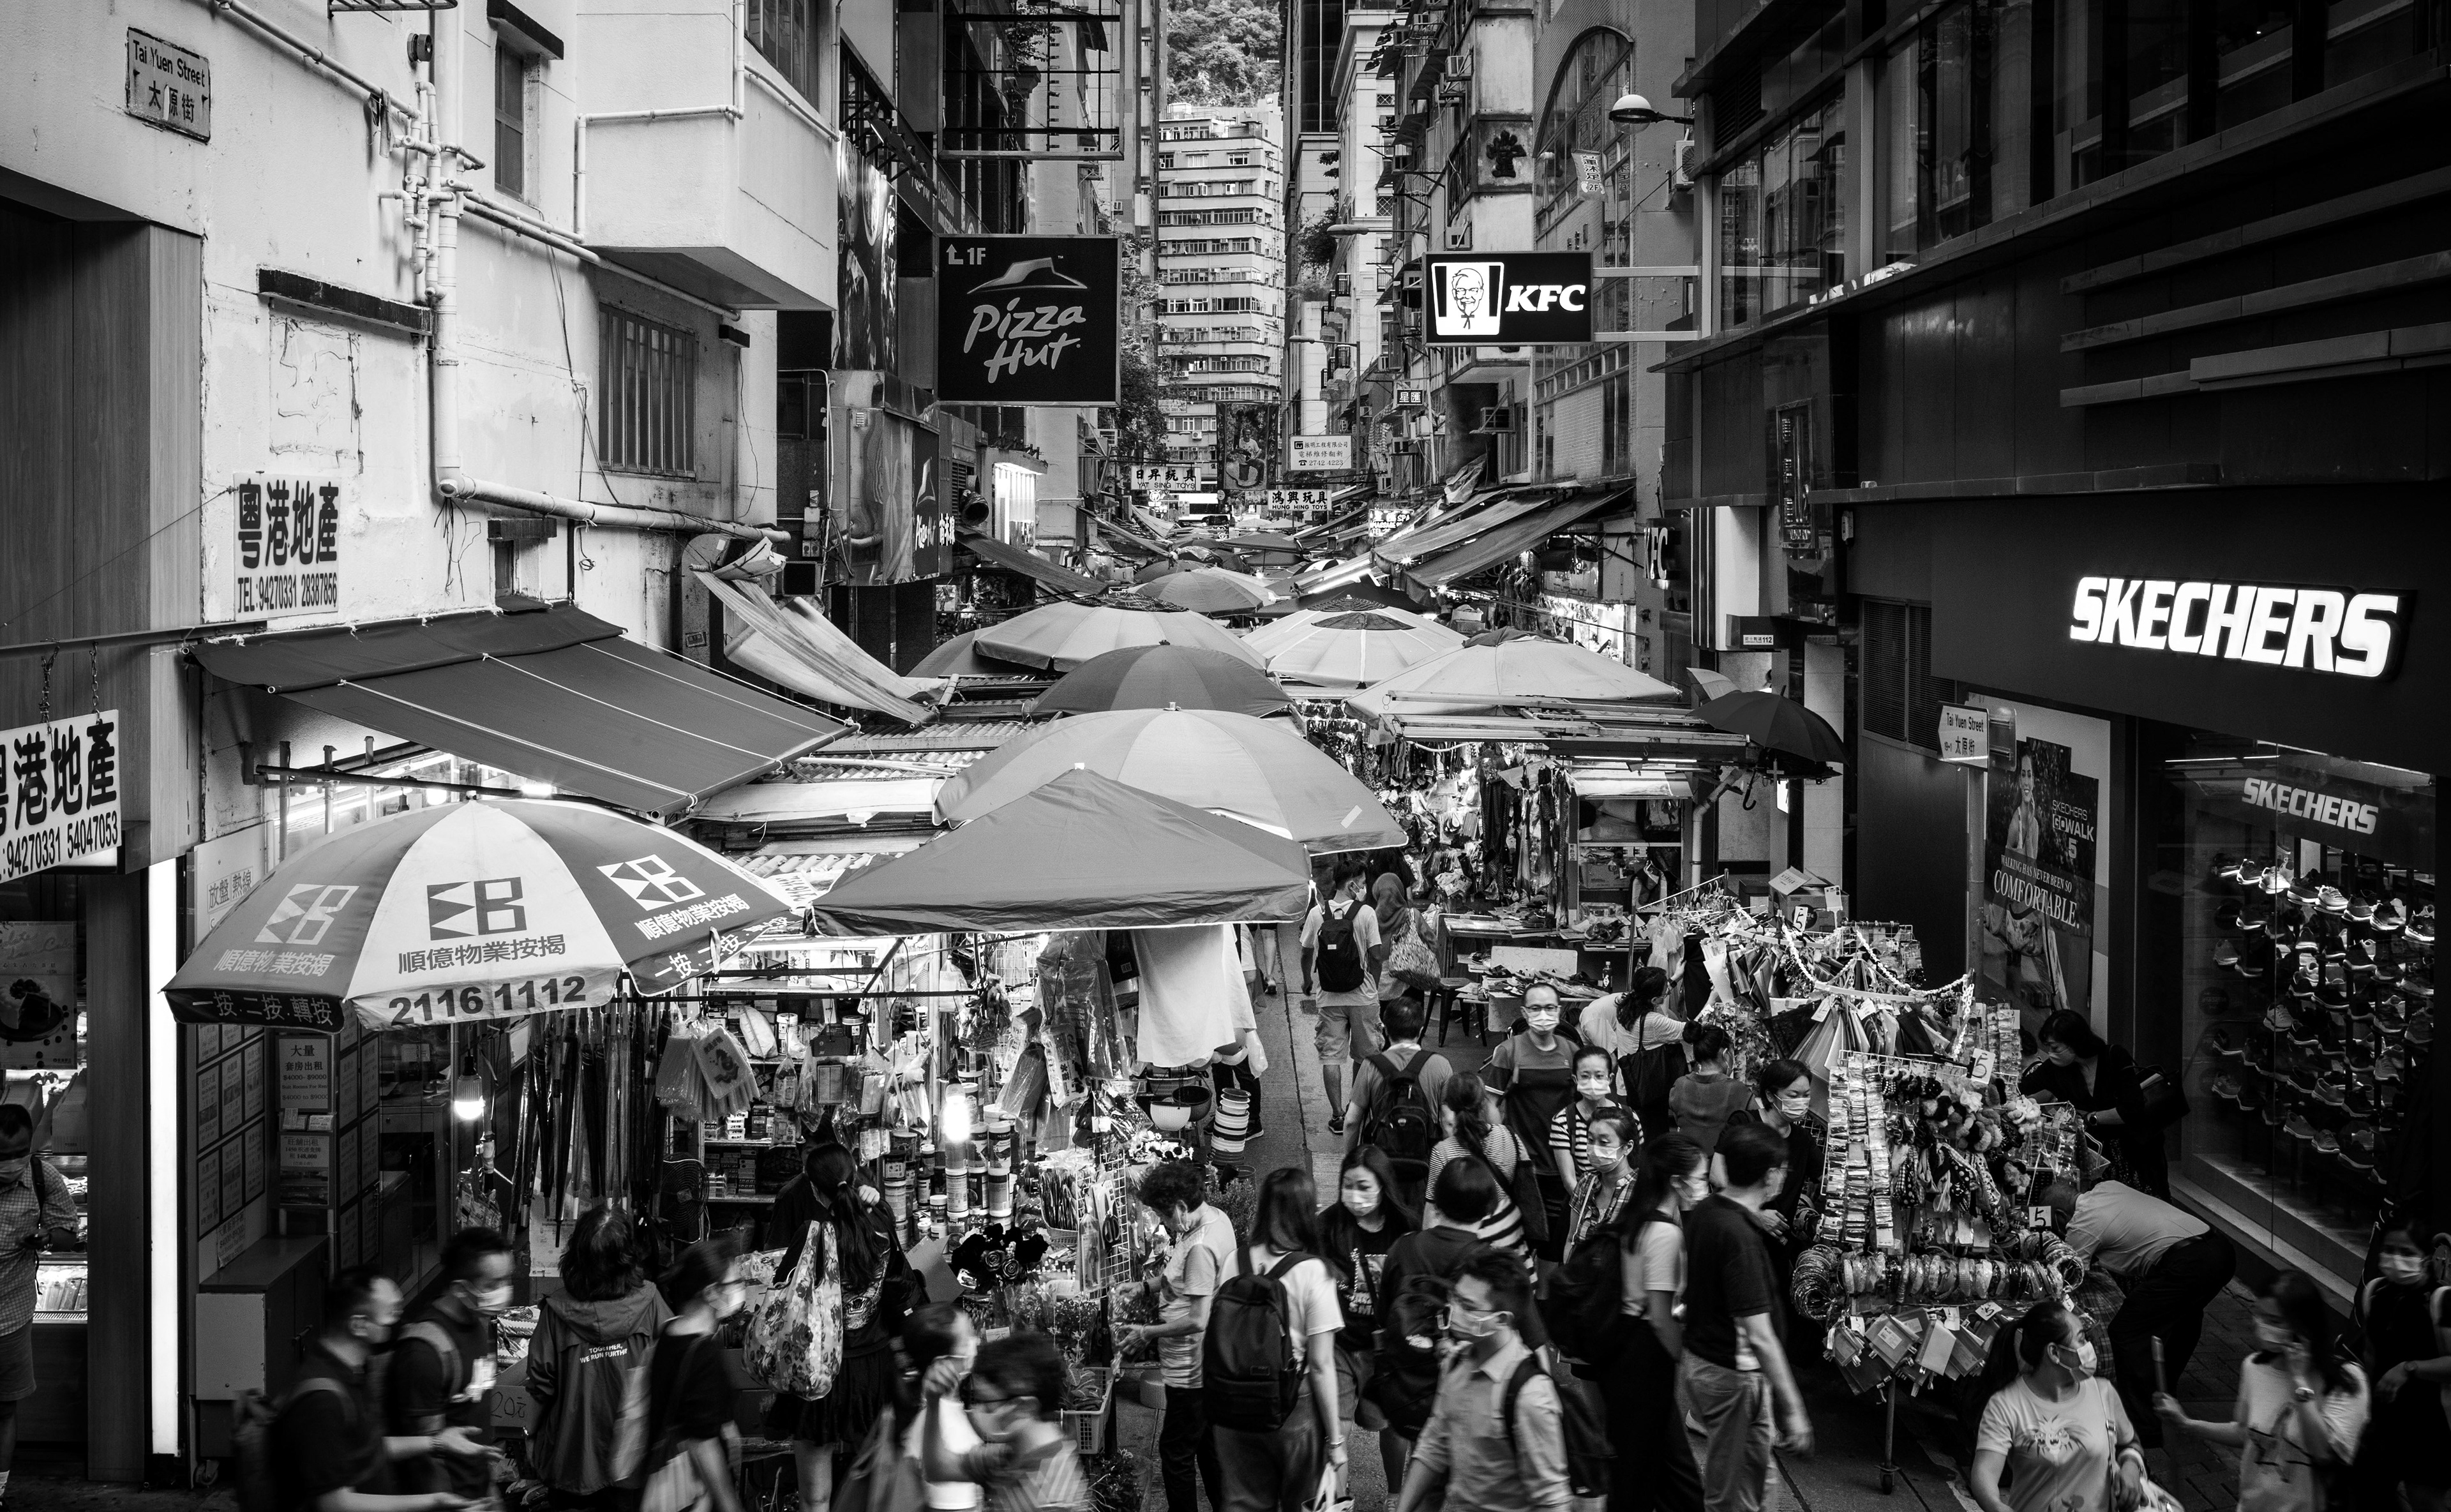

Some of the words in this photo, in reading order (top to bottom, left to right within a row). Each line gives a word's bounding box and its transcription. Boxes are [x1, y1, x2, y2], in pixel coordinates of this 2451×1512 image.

[133, 39, 147, 64] Tai
[150, 47, 173, 74] Yuen
[177, 57, 205, 87] Street
[148, 80, 195, 123] 太原街
[967, 247, 986, 265] 1F
[1504, 284, 1586, 312] KFC
[963, 297, 1086, 354] Pizza
[984, 333, 1081, 384] Hut
[1398, 392, 1421, 403] 星匯
[1136, 468, 1196, 482] 日昇玩具
[1272, 490, 1328, 504] 鴻興玩具
[237, 478, 339, 569] 粵港地產
[1644, 527, 1668, 580] KFC
[301, 573, 337, 608] 28387856
[2070, 576, 2399, 678] SKECHERS
[1955, 714, 1967, 729] Yuen
[1968, 716, 1984, 732] Street
[1955, 736, 1975, 758] 太原街
[2052, 800, 2088, 821] SKECHERS
[2244, 777, 2379, 835] SKECHERS
[67, 811, 118, 859] 54047053
[2068, 837, 2077, 859] 5
[2001, 854, 2022, 873] WALKING
[2022, 863, 2032, 878] HAS
[2032, 867, 2050, 885] NEVER
[2050, 875, 2065, 890] BEEN
[2065, 880, 2072, 894] SO
[1993, 869, 2080, 929] COMFORTABLE.
[634, 894, 751, 941] 順億物業按揭
[214, 949, 336, 977] 順億物業按揭
[398, 934, 566, 975] 順億物業按揭
[388, 987, 484, 1026] 2116
[494, 976, 587, 1012] 1112
[290, 1045, 315, 1057] 大量
[285, 1061, 324, 1071] 套房出租
[1972, 1054, 1989, 1079] 5
[287, 1138, 319, 1146] 旺舖出租
[2034, 1208, 2047, 1227] 5
[580, 1356, 590, 1364] WE
[590, 1352, 604, 1361] RUN
[605, 1348, 628, 1358] FURTH
[588, 1344, 623, 1354] TOGETHER,
